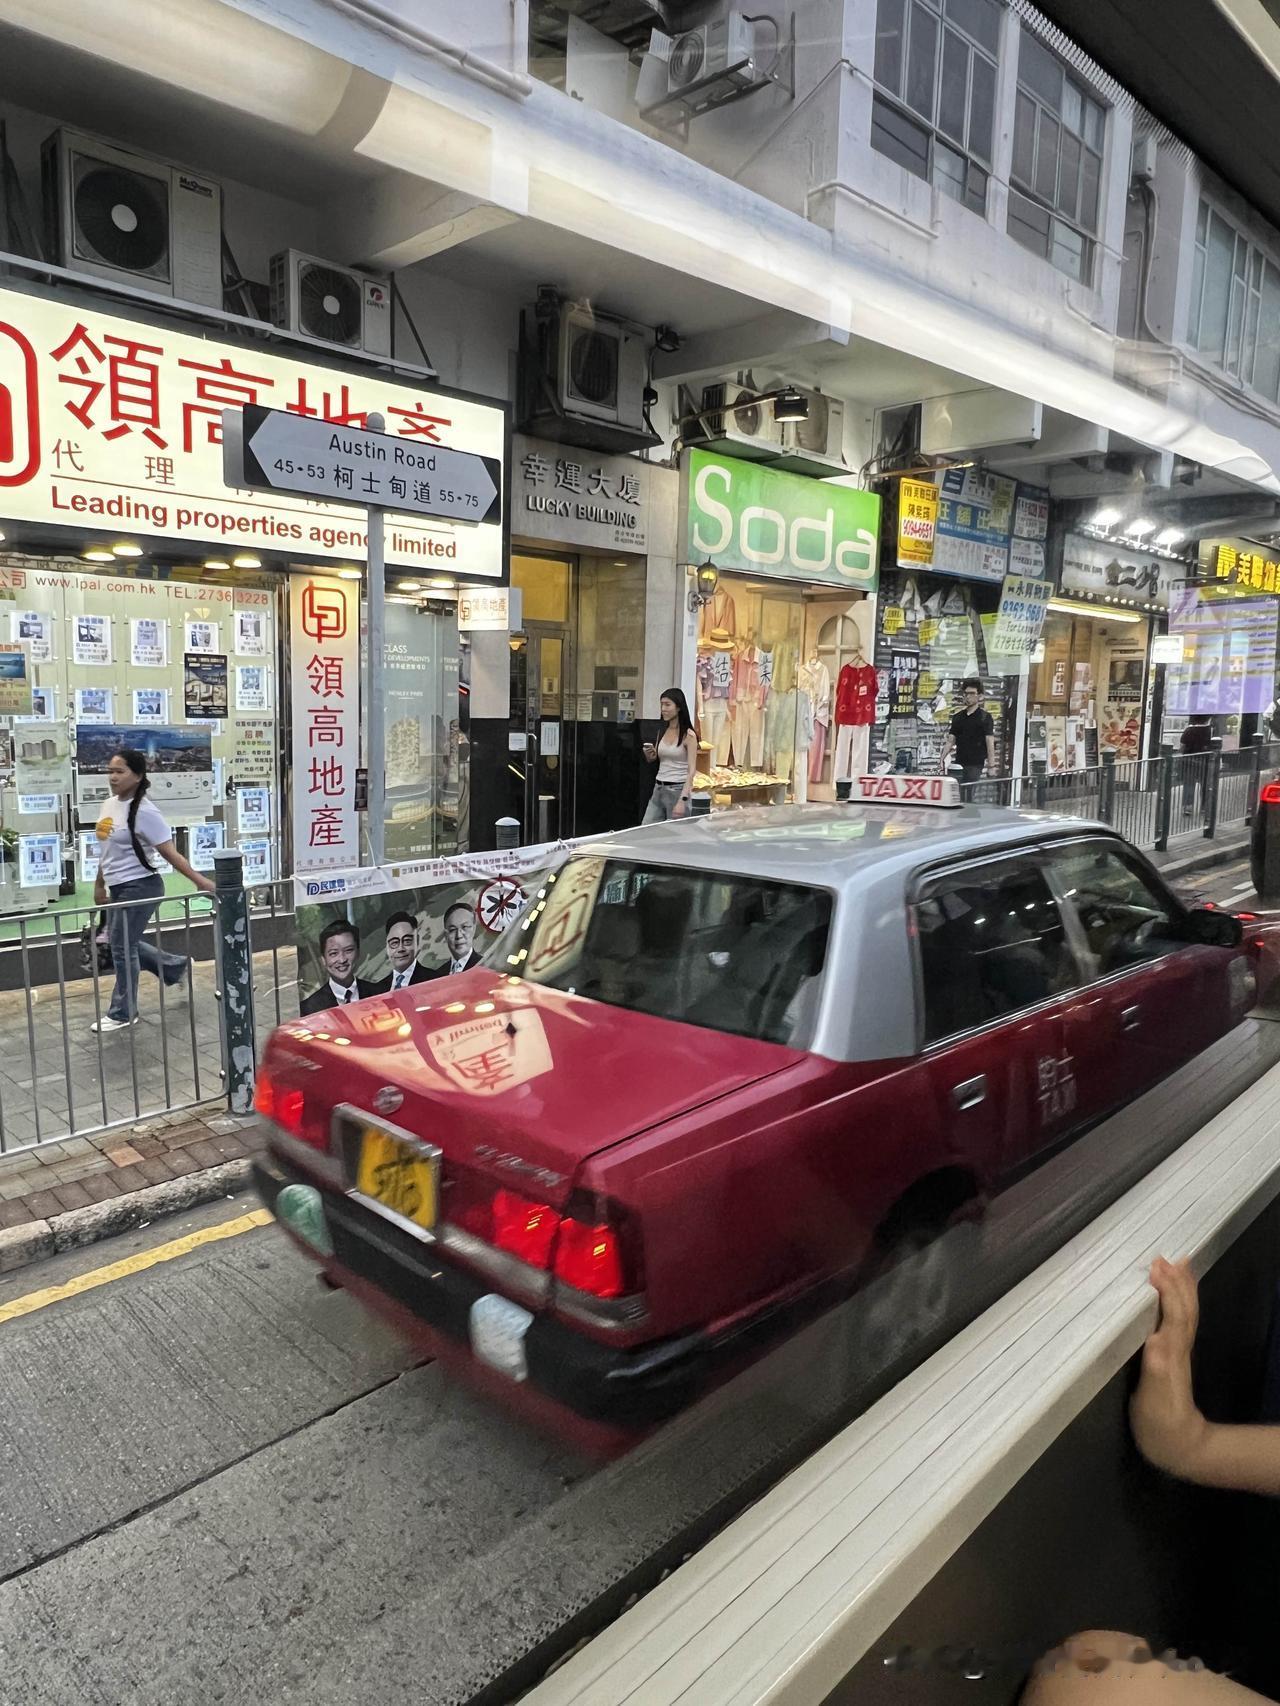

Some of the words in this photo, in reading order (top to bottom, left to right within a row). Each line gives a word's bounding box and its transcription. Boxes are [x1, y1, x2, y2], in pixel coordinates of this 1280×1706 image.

[329, 433, 387, 462] Austin
[394, 447, 437, 471] Road
[333, 464, 432, 505] 柯士甸道
[521, 453, 641, 506] 幸運大廈
[52, 486, 168, 528] Leading
[176, 507, 302, 539] properties
[392, 533, 457, 558] limited
[527, 495, 574, 518] LUCKY
[576, 503, 638, 530] BUILDING
[693, 464, 877, 580] Soda
[306, 654, 346, 848] 領高地產
[858, 776, 944, 801] TAXI
